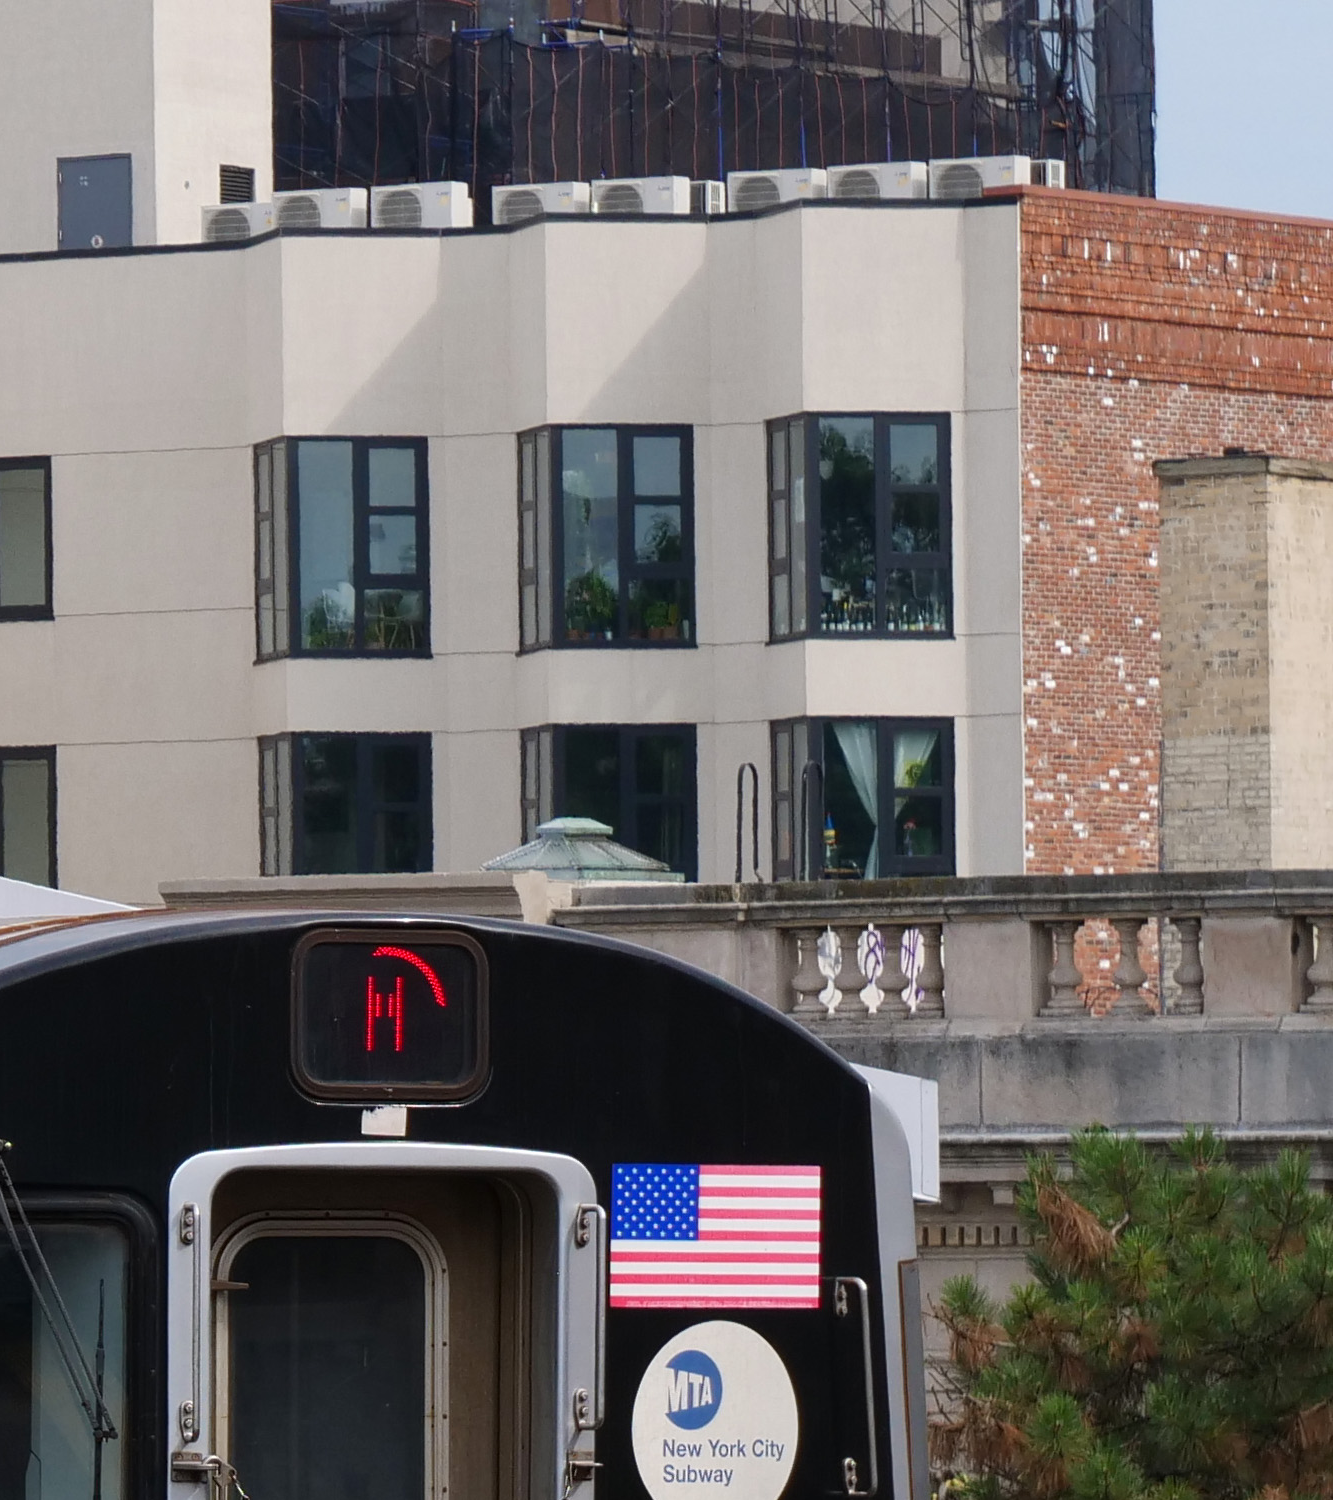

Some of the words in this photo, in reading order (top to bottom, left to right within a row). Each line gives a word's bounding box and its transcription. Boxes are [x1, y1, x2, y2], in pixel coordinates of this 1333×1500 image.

[662, 1438, 703, 1458] New
[708, 1438, 747, 1458] York
[751, 1438, 785, 1462] City
[662, 1464, 734, 1487] Subway
